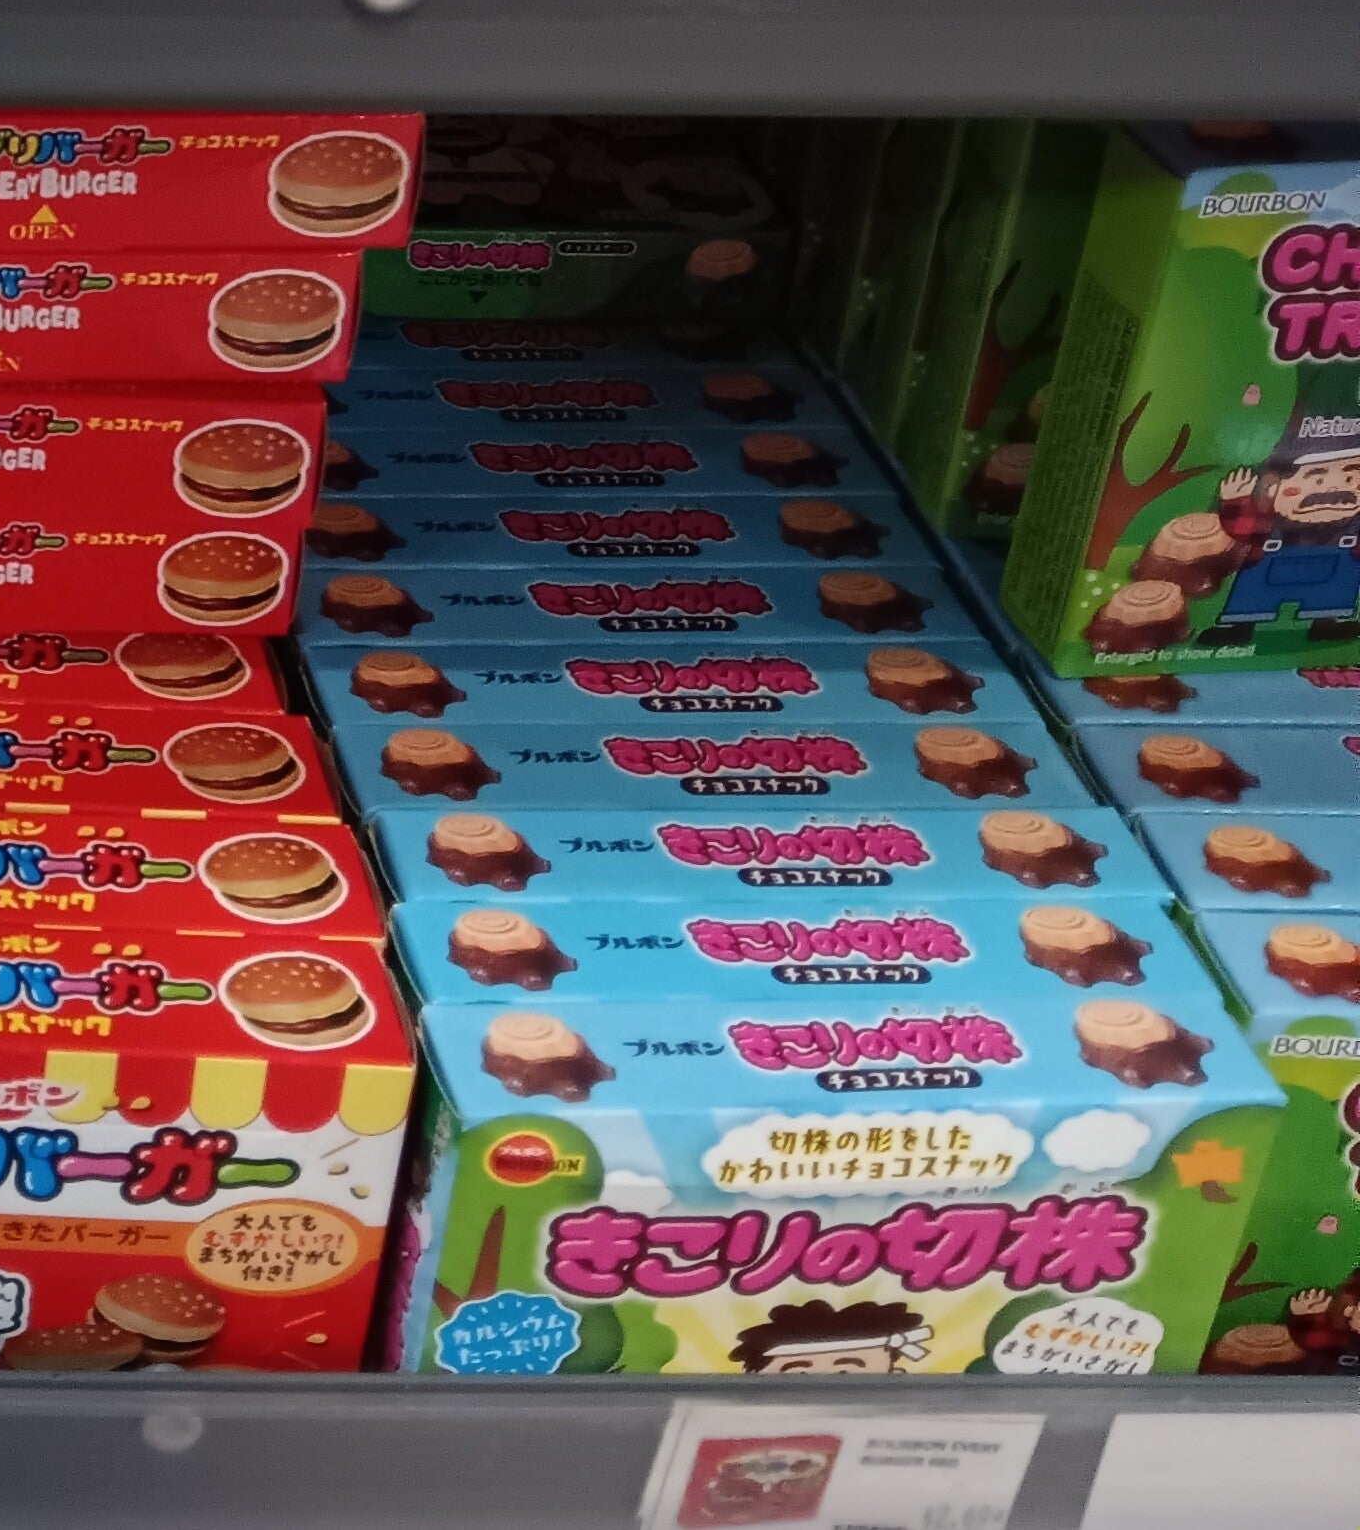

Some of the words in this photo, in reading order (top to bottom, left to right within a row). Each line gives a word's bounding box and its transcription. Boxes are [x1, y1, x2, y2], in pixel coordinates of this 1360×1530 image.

[1199, 191, 1327, 217] BOURBON
[6, 223, 79, 241] OPEN
[585, 932, 685, 952] ブルボン
[782, 965, 923, 984] チョコスナック
[768, 1126, 973, 1155] 切株の形をした
[716, 1152, 1014, 1186] かわいいチョコスナック
[544, 1194, 1150, 1298] きこりの切株
